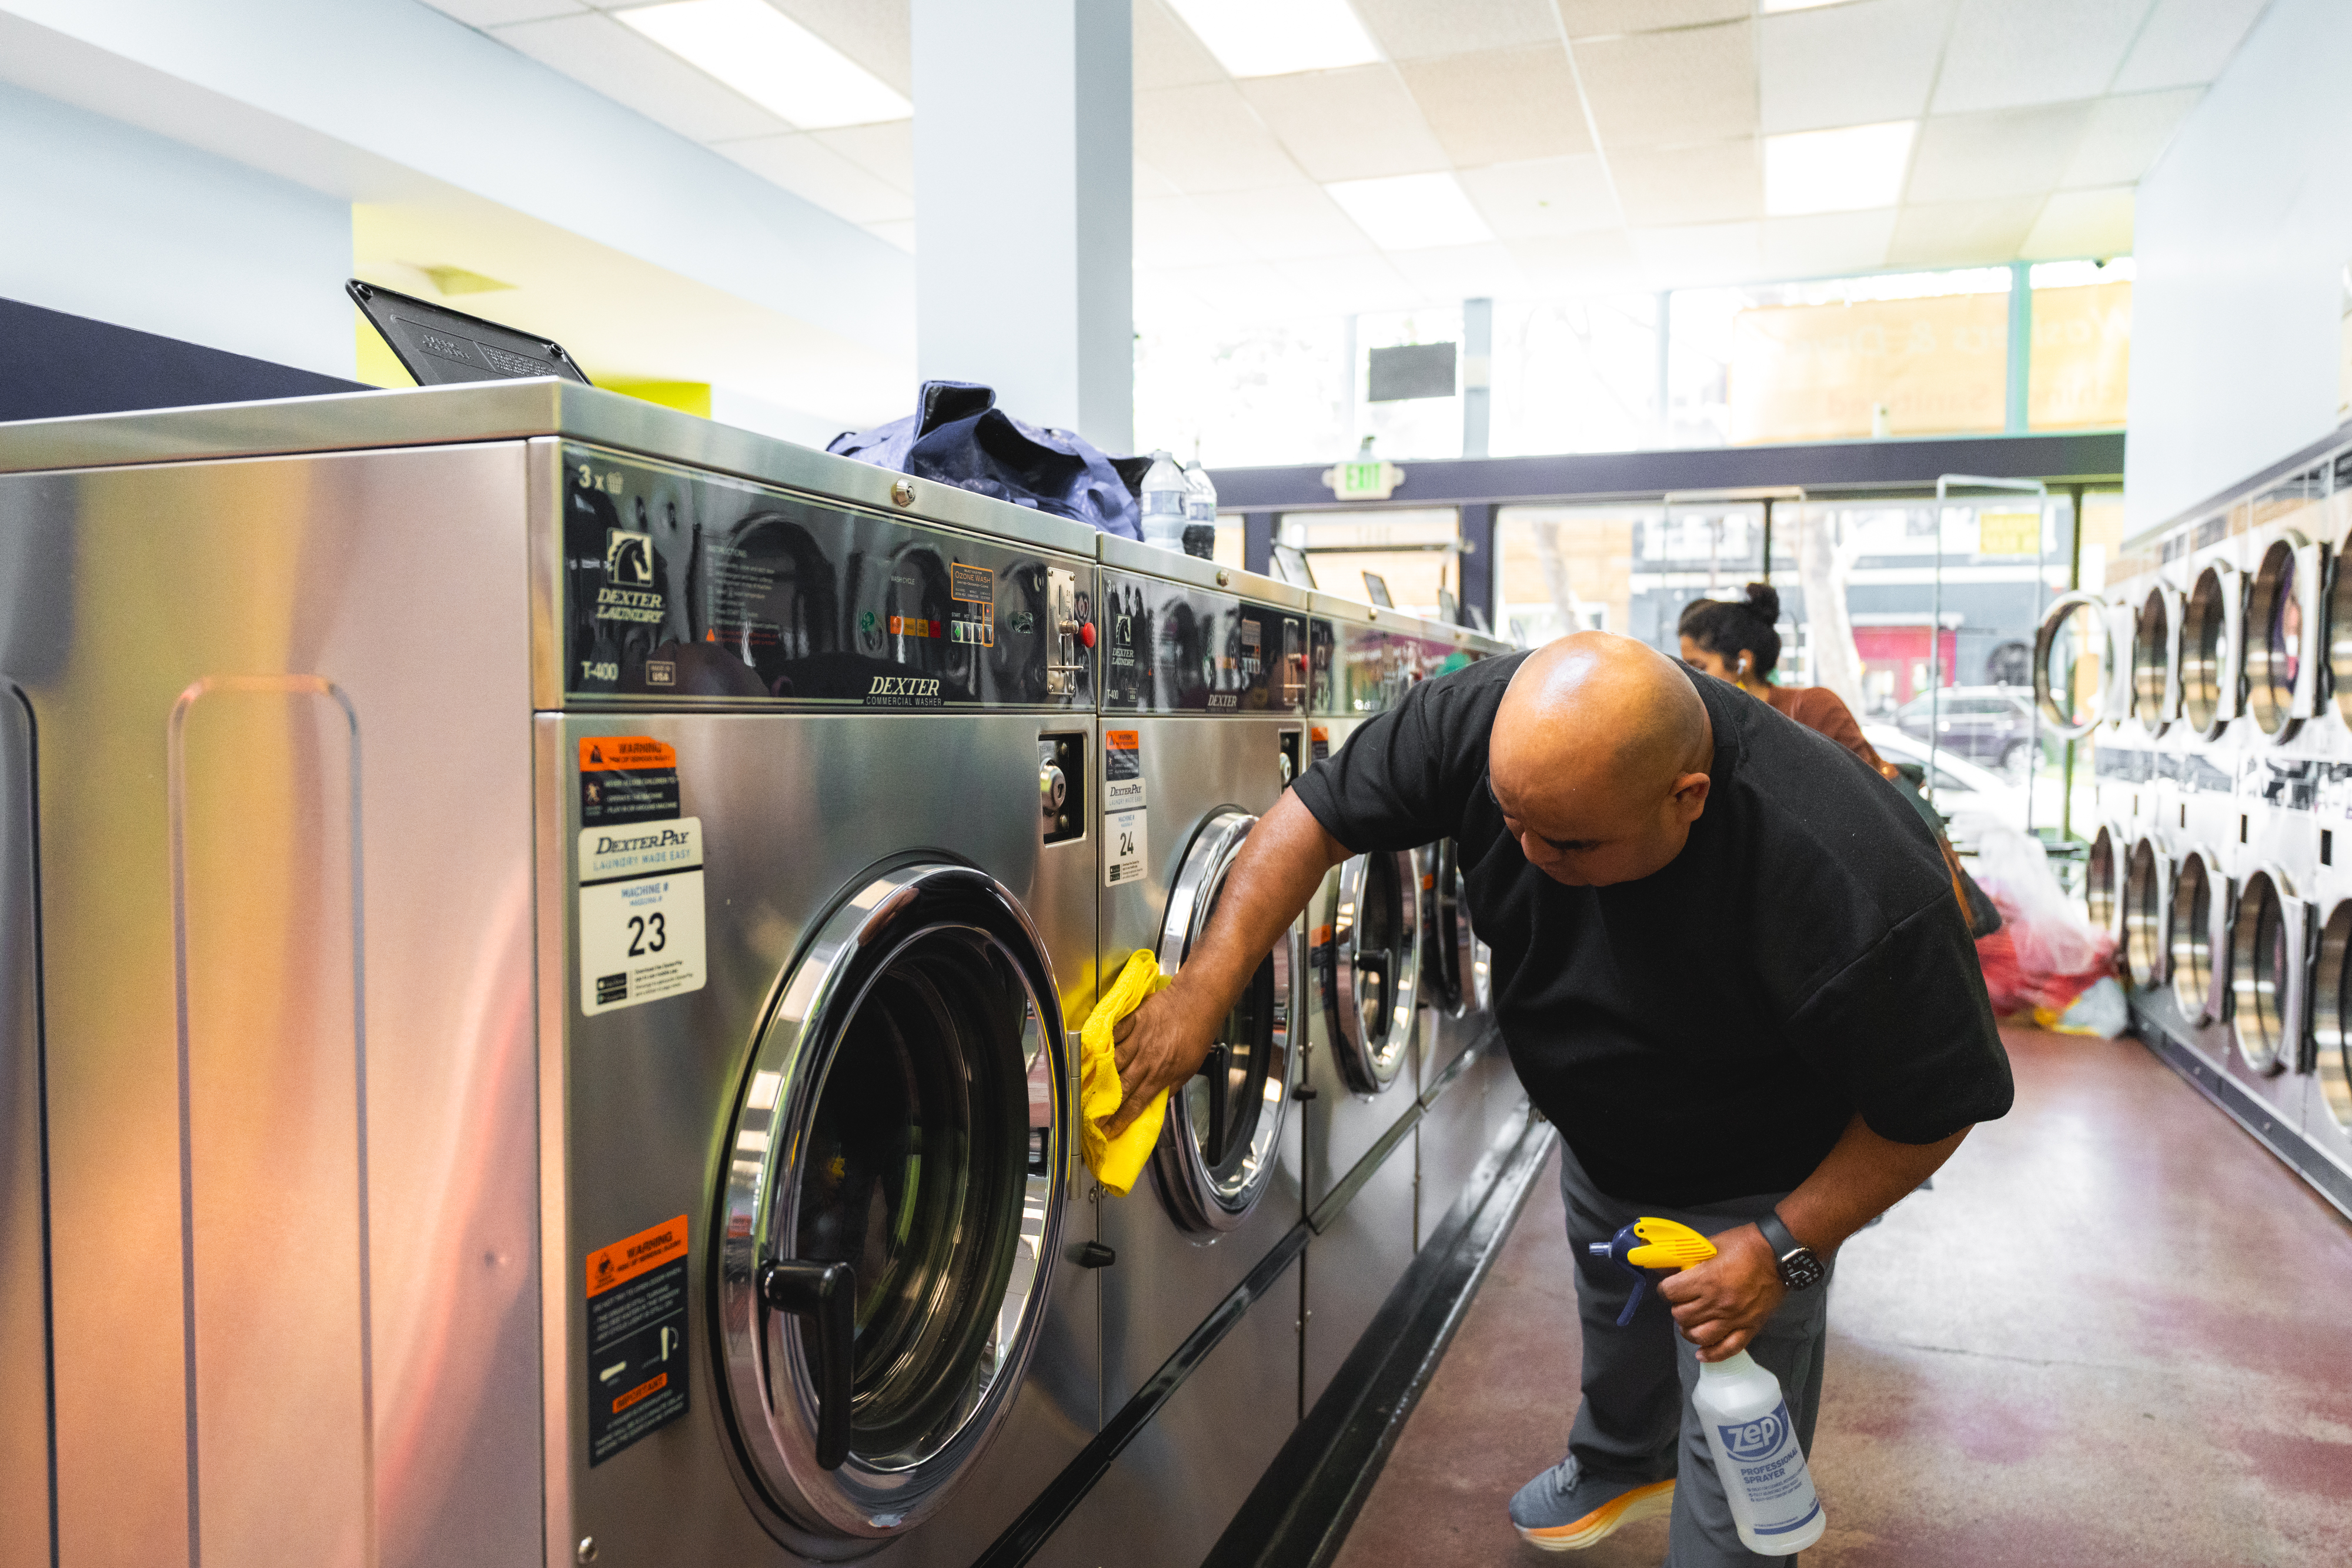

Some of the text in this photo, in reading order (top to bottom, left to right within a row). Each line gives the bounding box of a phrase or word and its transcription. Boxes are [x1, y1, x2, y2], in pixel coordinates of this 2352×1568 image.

[579, 464, 591, 488] 3
[1346, 462, 1381, 492] EXIT
[903, 577, 915, 585] CYCLE
[955, 571, 991, 583] OZONE WASH
[1107, 580, 1111, 592] 3
[597, 587, 663, 609] DEXTER
[596, 604, 665, 624] LAUNDRY
[1112, 648, 1134, 658] DEXTER
[1112, 657, 1135, 667] LAUNDRY
[581, 660, 619, 681] T-400
[868, 676, 940, 696] DEXTER
[1107, 688, 1119, 700] T-400
[866, 696, 941, 706] COMMERCIAL WASHER
[1208, 694, 1237, 707] DEXTER
[1120, 831, 1134, 857] 24
[593, 848, 690, 871] LAUNDRY MADE EASY
[621, 882, 661, 899] MACHINE
[629, 912, 665, 957] 23
[1740, 1446, 1798, 1476] PROFESSIONAL
[1743, 1467, 1786, 1484] SPRAYER
